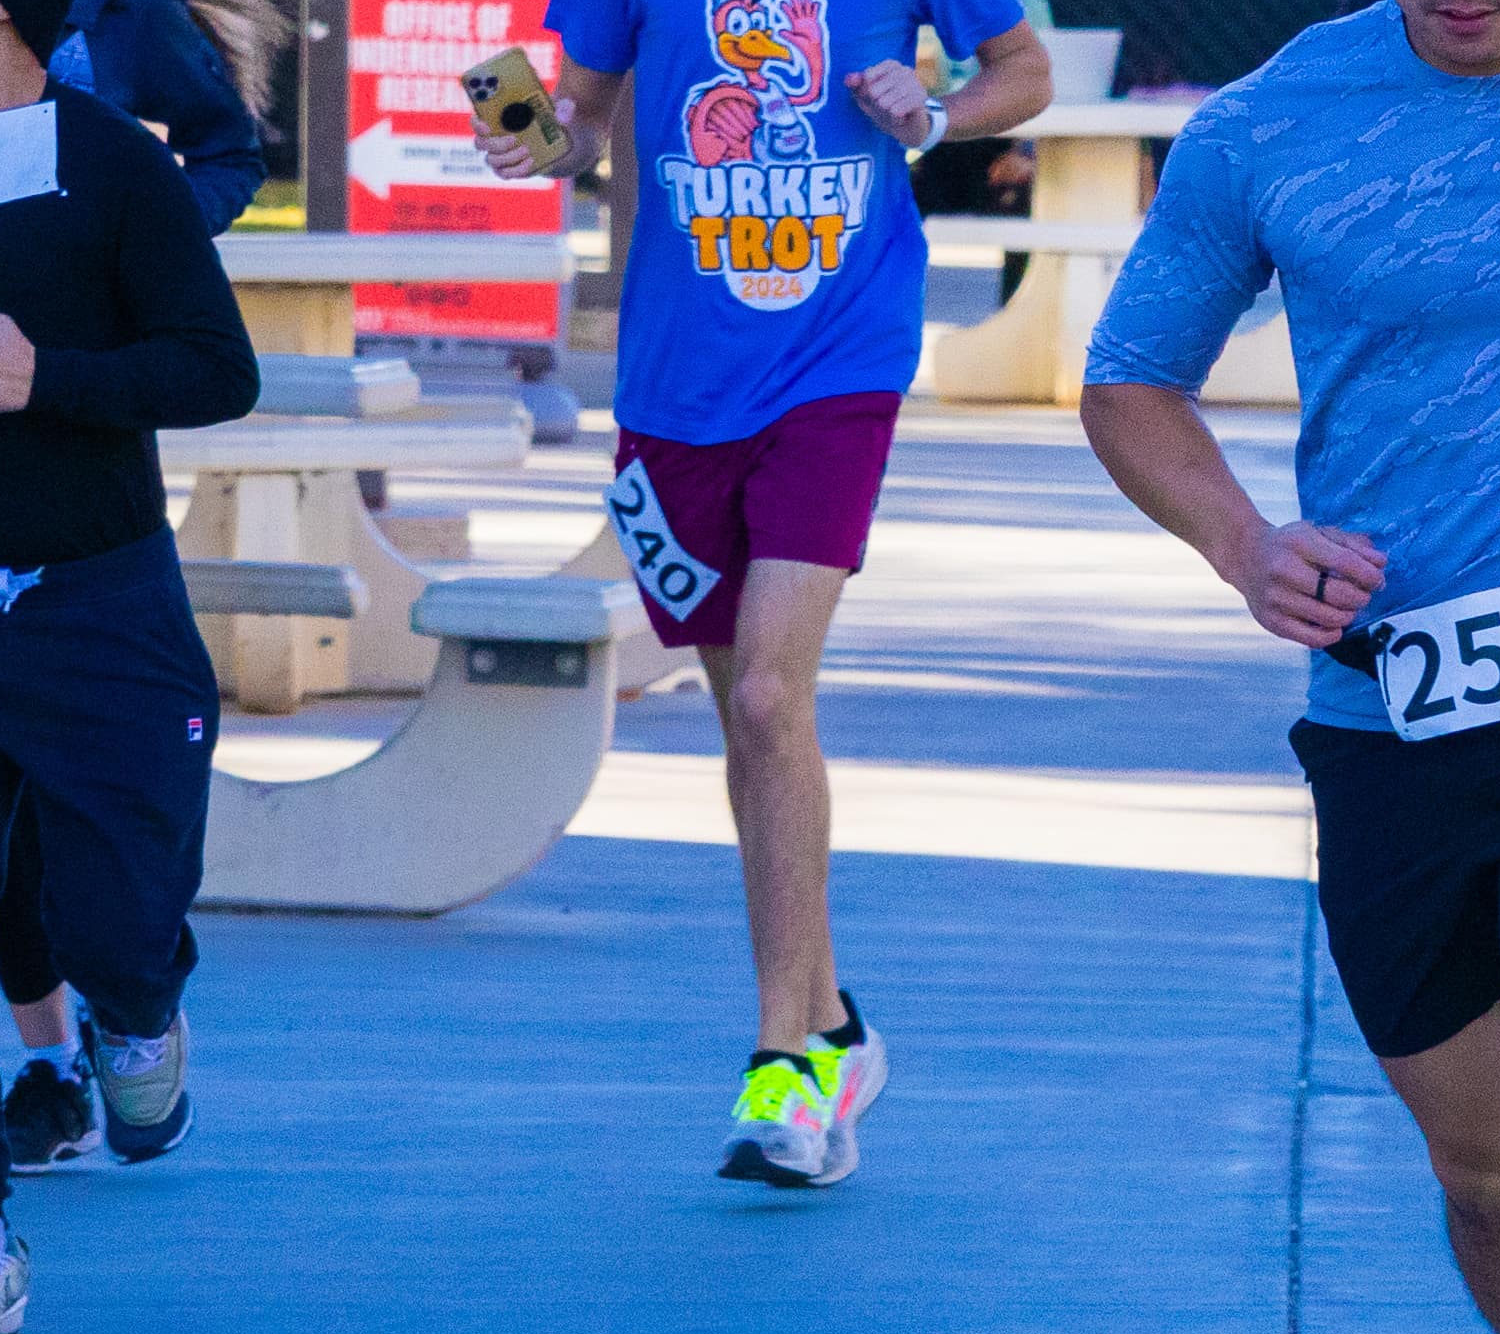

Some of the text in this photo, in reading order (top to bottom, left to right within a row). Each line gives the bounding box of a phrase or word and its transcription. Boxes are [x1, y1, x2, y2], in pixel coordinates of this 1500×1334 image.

[662, 155, 873, 230] TURKEY
[690, 214, 845, 272] TROT
[739, 276, 804, 300] 2024
[609, 477, 699, 604] 240
